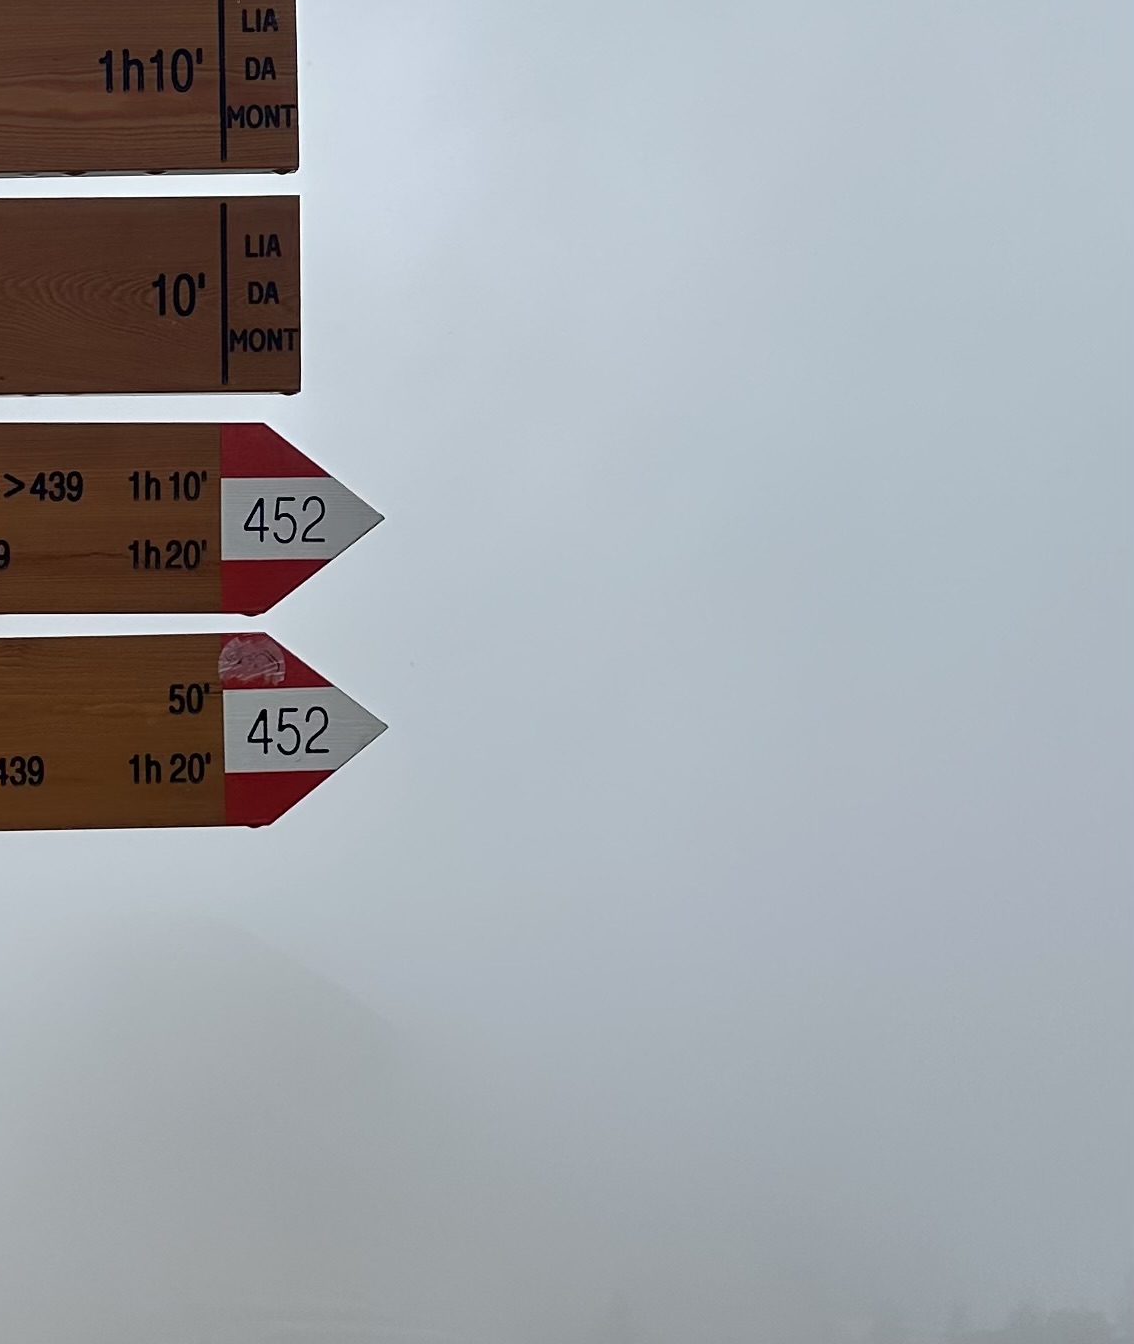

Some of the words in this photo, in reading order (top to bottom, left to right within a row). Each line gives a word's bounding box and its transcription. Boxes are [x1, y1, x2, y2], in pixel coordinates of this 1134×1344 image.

[241, 8, 279, 33] LIA
[98, 47, 203, 94] 1h10'
[244, 56, 277, 81] DA
[226, 104, 295, 129] MONT
[244, 233, 282, 258] LIA
[151, 272, 206, 317] 10'
[247, 281, 280, 305] DA
[229, 327, 299, 353] MONT
[243, 495, 326, 544] 452
[168, 682, 210, 715] 50'
[247, 706, 330, 756] 452
